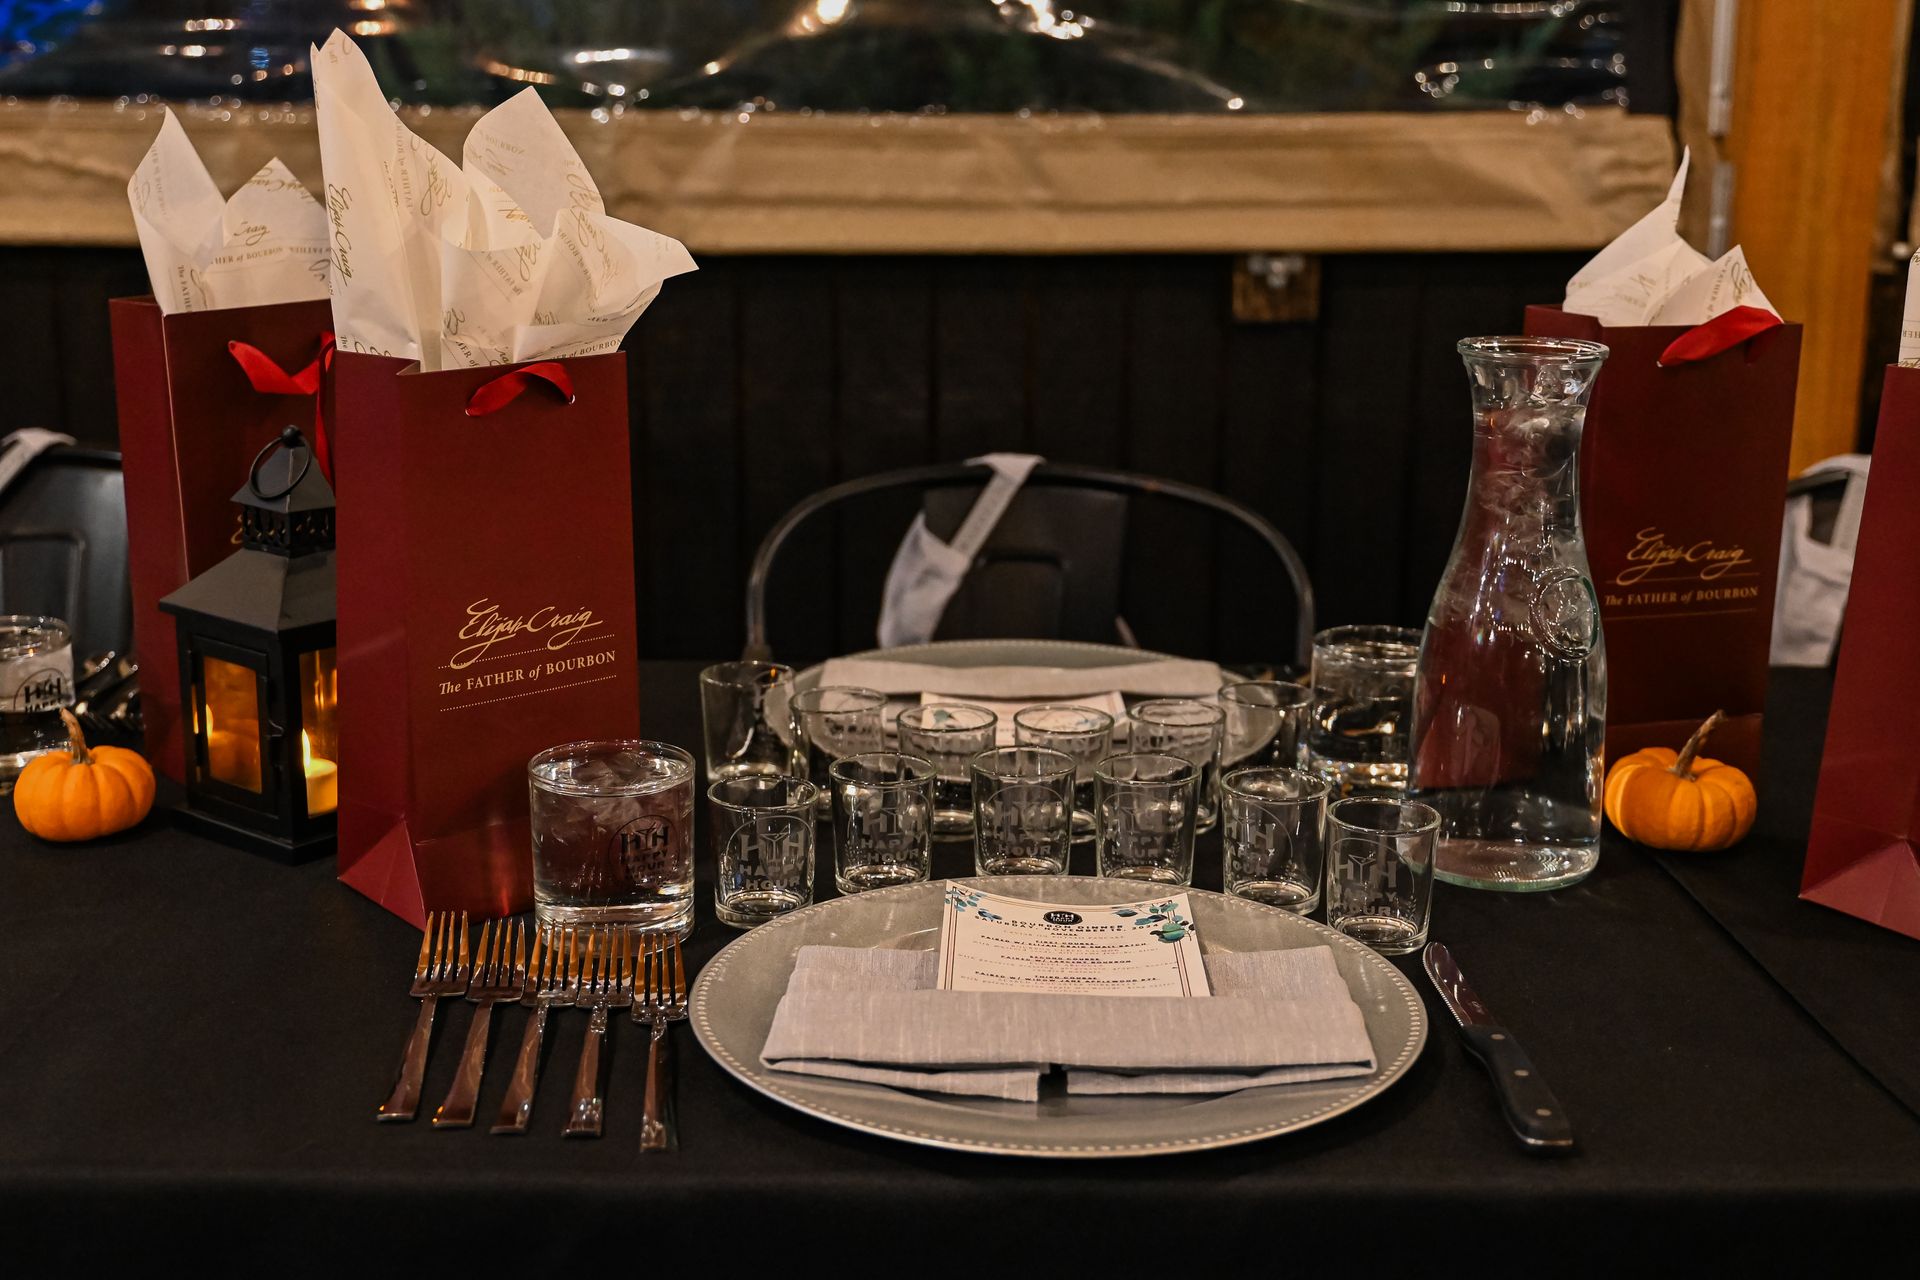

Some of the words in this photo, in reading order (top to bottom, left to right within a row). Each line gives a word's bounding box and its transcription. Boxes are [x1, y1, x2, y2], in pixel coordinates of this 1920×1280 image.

[328, 183, 353, 232] Elijah
[209, 254, 235, 266] HER
[236, 254, 244, 263] of
[330, 230, 353, 287] Craig
[1616, 527, 1684, 586] Elijah
[1683, 541, 1752, 580] Craig
[1605, 595, 1623, 606] The
[1627, 591, 1678, 606] FATHER
[1681, 590, 1693, 605] of
[1696, 586, 1759, 600] BOURBON
[450, 597, 528, 670] Elijah
[526, 605, 603, 651] Craig
[439, 681, 461, 695] The
[466, 667, 525, 691] FATHER
[528, 664, 542, 681] of
[546, 650, 616, 675] BOURBON
[745, 875, 801, 890] HOUR
